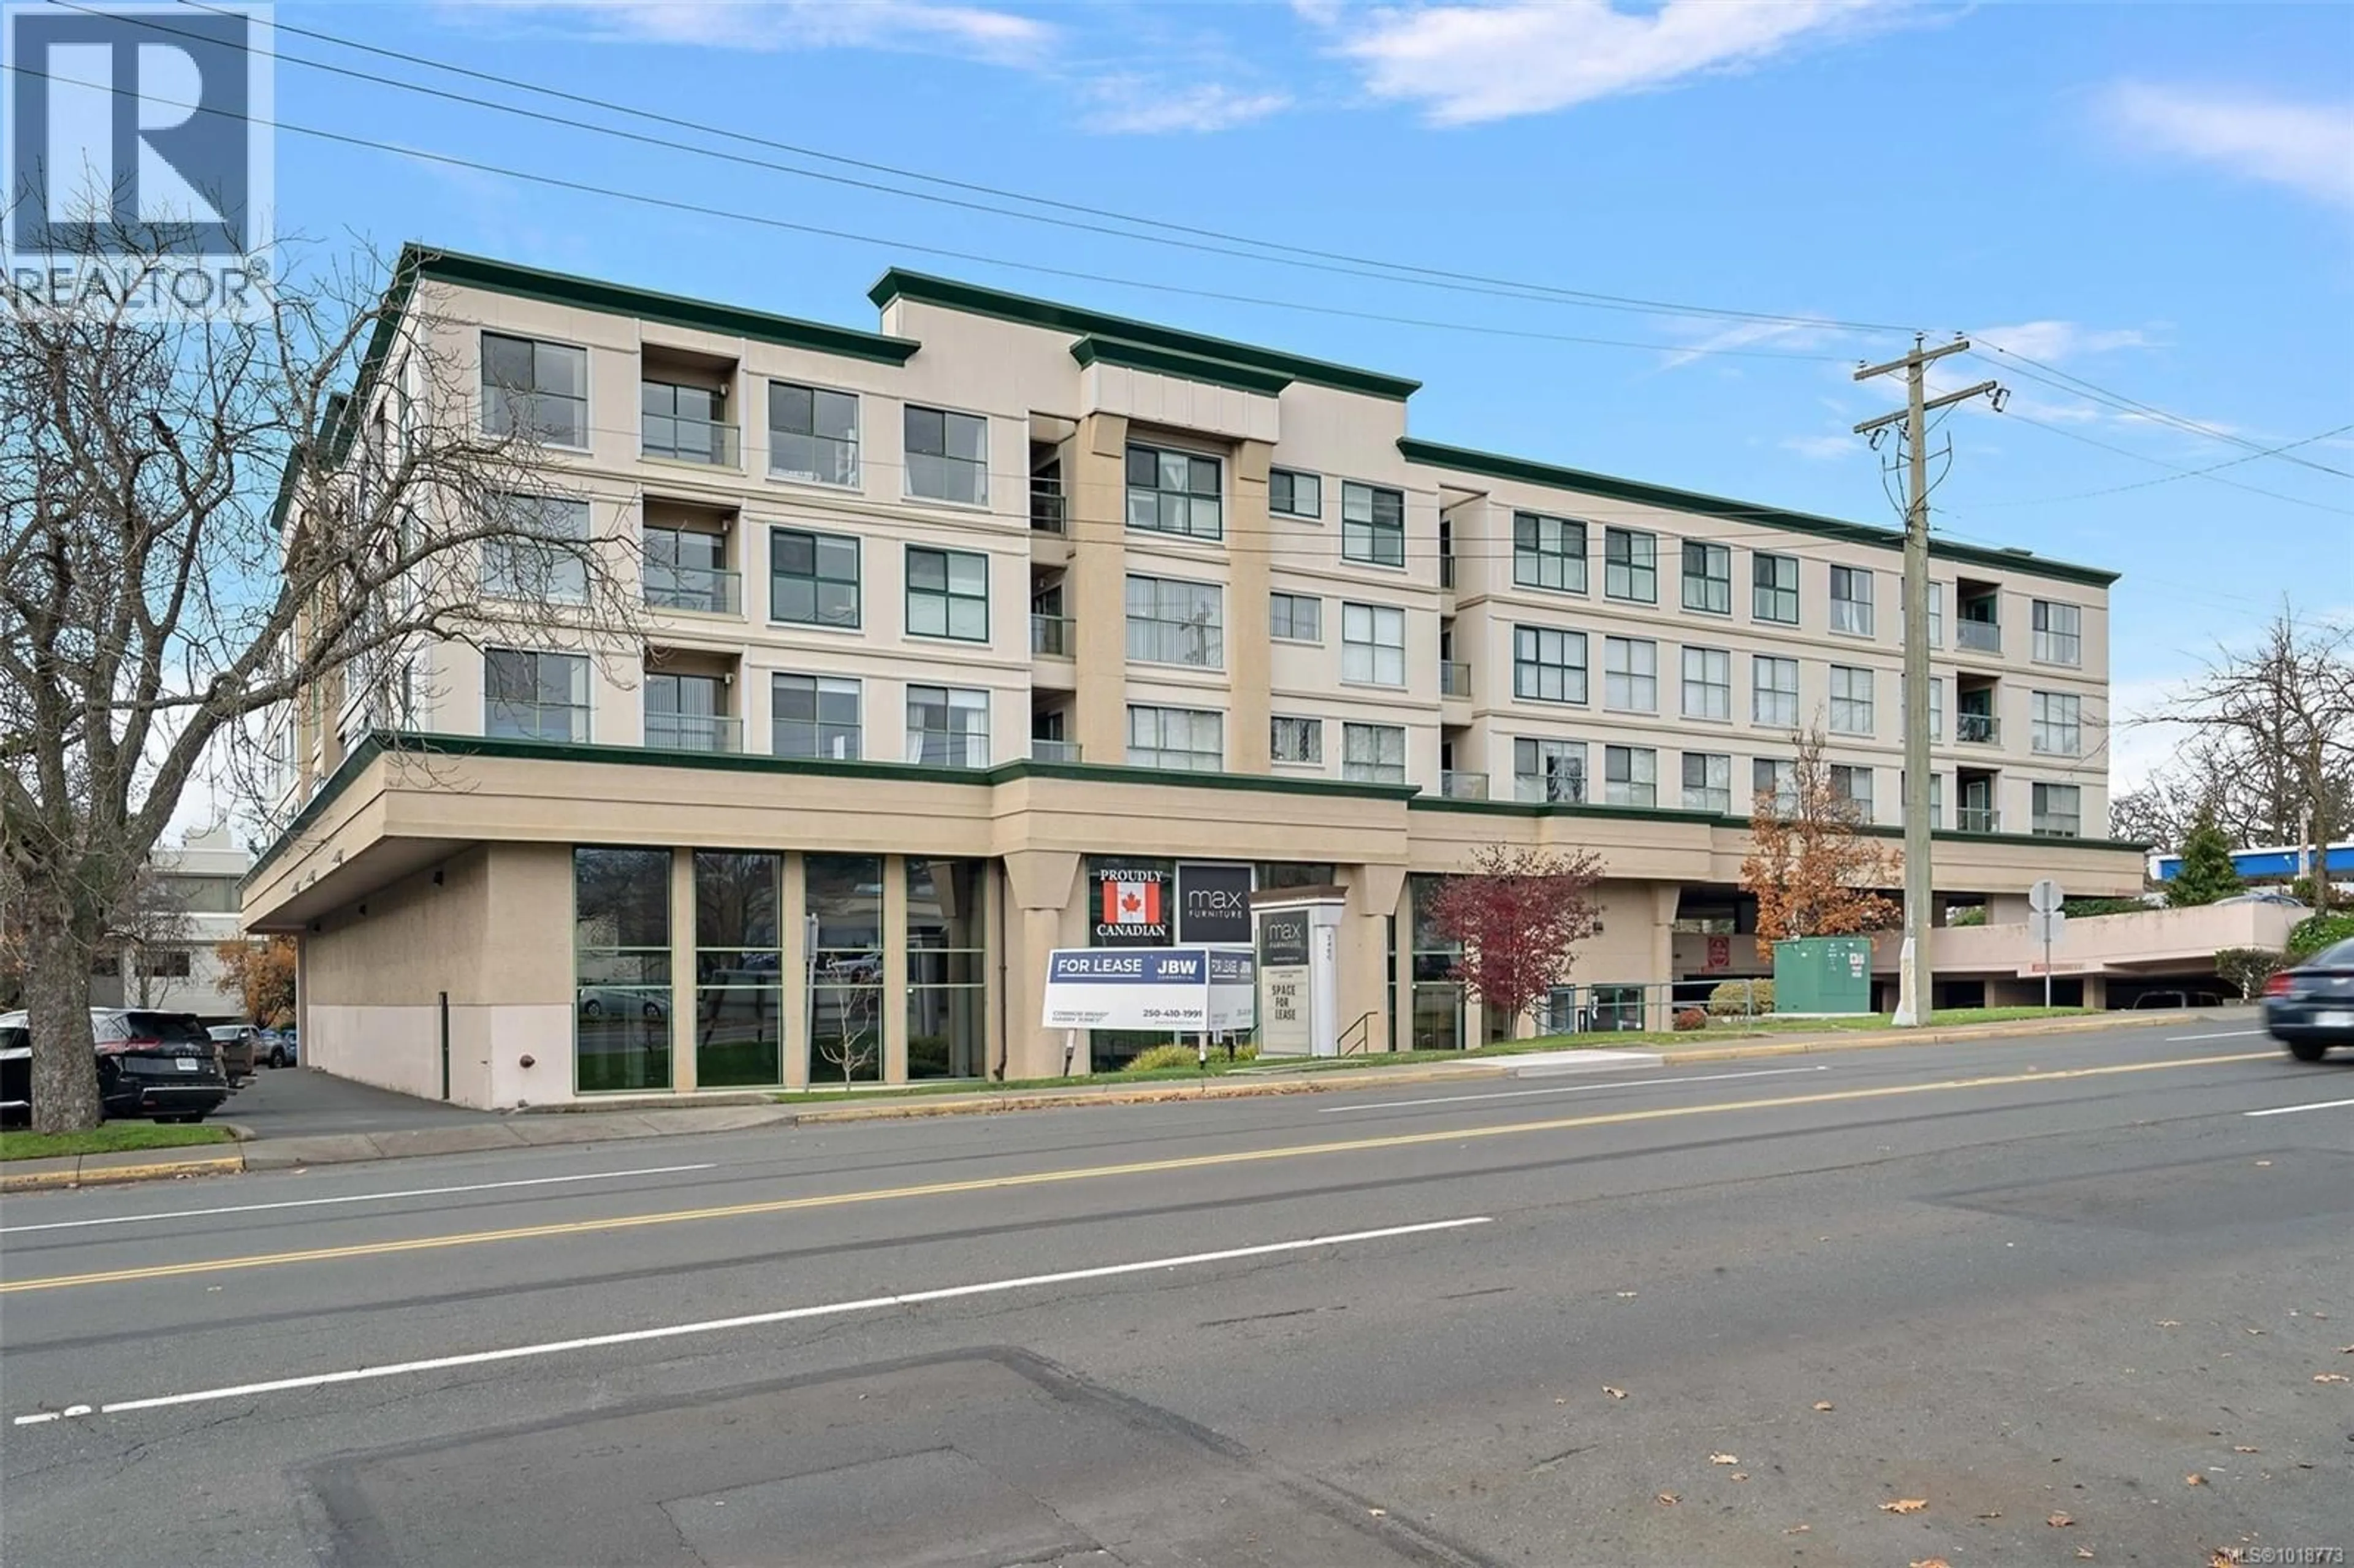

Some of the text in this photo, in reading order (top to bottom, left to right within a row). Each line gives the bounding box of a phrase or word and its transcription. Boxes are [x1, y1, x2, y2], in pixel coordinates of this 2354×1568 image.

[1100, 869, 1164, 882] PROUDLY
[1189, 890, 1243, 909] max
[1189, 910, 1243, 919] FURNITURE
[1096, 924, 1166, 937] CANADIAN
[1270, 923, 1301, 940] max
[1057, 959, 1197, 975] FOR LEASE JBW
[1272, 984, 1295, 995] SPACE
[1275, 997, 1289, 1007] FOR
[1143, 1009, 1202, 1018] 250-410-1991
[1275, 1009, 1295, 1021] LEASE
